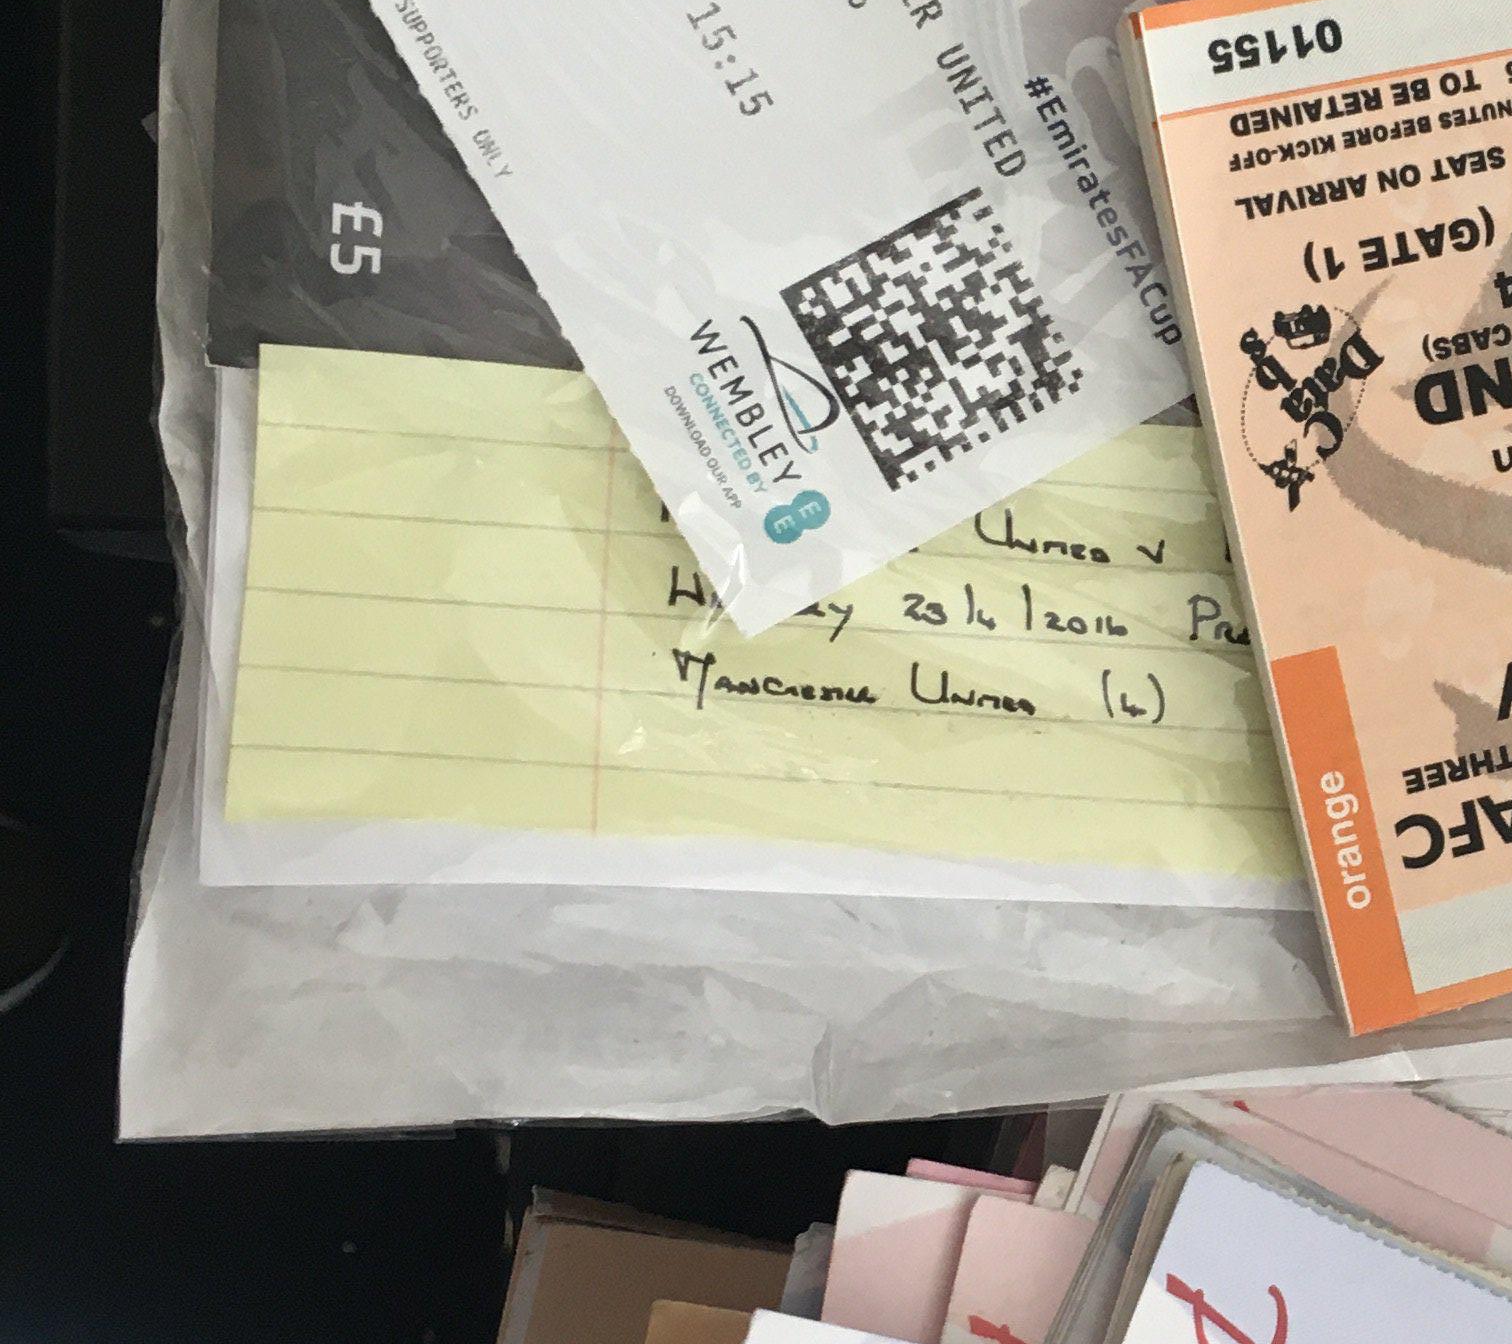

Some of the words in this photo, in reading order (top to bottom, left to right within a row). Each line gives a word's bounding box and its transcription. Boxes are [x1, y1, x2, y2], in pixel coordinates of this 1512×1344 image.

[1205, 17, 1344, 76] 01155
[940, 40, 1030, 179] UNITED
[1393, 80, 1432, 108] BE
[1440, 71, 1482, 98] TO
[1229, 87, 1384, 138] RETAINED
[1378, 164, 1423, 196] ON
[1430, 142, 1508, 182] SEAT
[1022, 73, 1184, 346] #EmiratesFACup
[1234, 171, 1369, 222] ARRIVAL
[329, 200, 384, 279] £5
[1303, 240, 1348, 284] 1)
[1358, 205, 1495, 277] (GATE
[687, 316, 804, 487] WEMBLEY
[687, 371, 759, 475] CONNECTED
[740, 470, 770, 497] BY
[1402, 744, 1511, 796] THREE
[1317, 769, 1374, 912] orange
